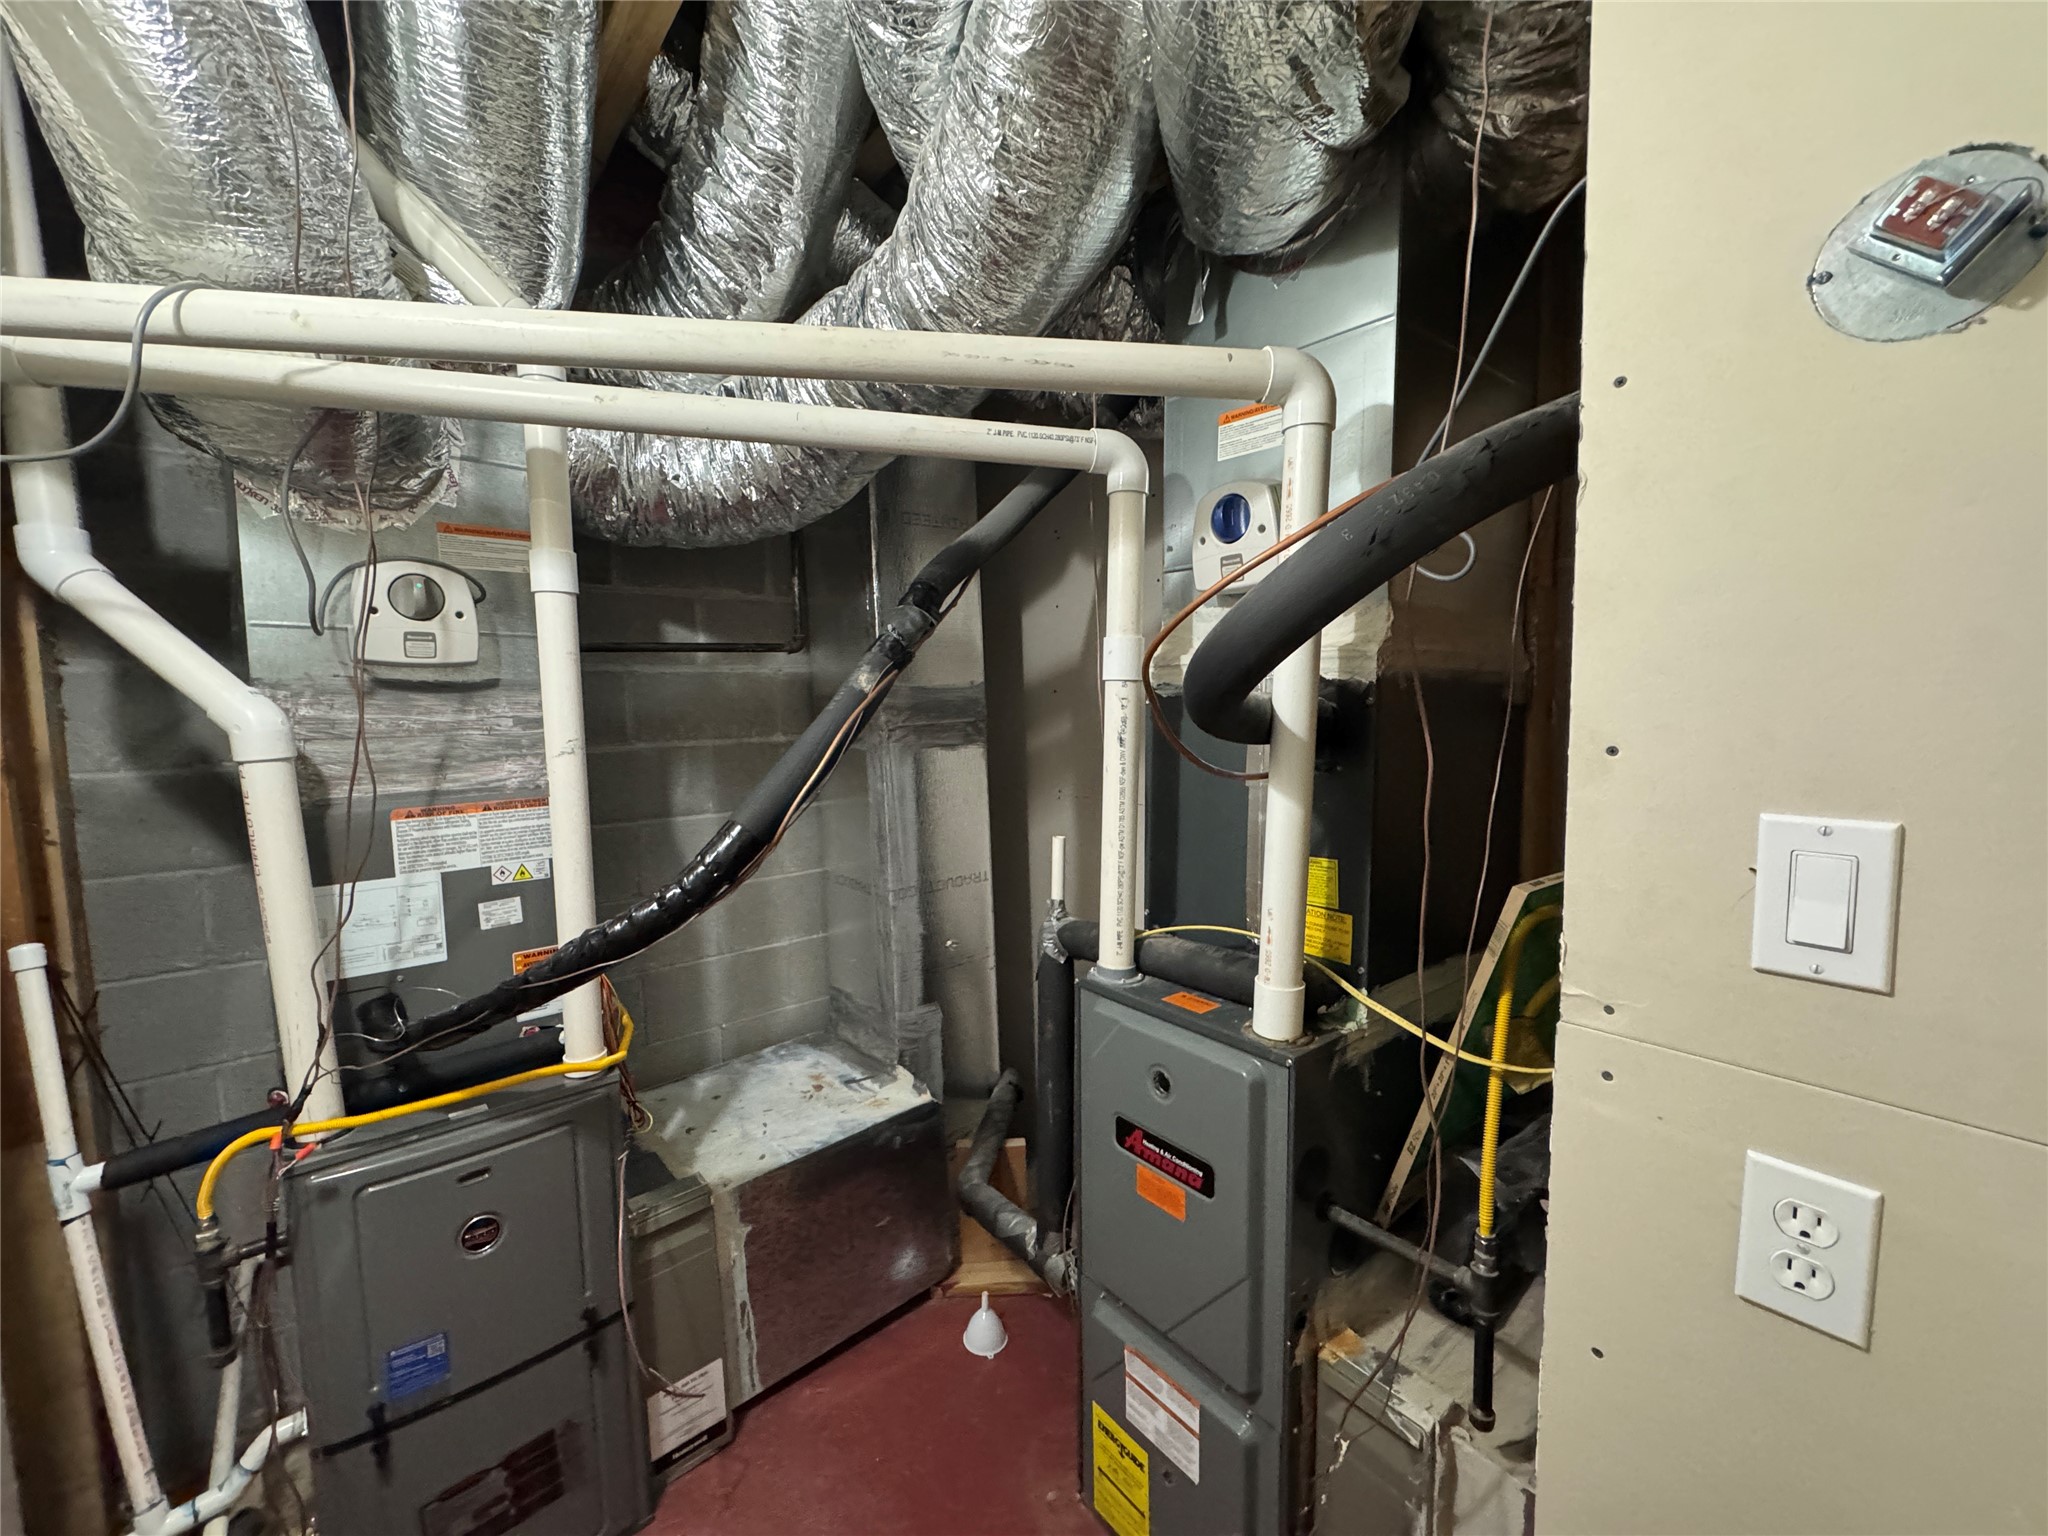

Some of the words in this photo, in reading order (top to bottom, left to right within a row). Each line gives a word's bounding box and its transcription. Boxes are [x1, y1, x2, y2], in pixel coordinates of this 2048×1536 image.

[1002, 430, 1014, 438] PIPE
[1017, 430, 1028, 438] PVC
[420, 805, 456, 814] WARNING
[522, 948, 560, 960] WARNIN
[1124, 1129, 1204, 1189] Amana
[1142, 1139, 1160, 1153] Heating
[1164, 1151, 1172, 1160] Air
[1172, 1155, 1203, 1177] Conditioning
